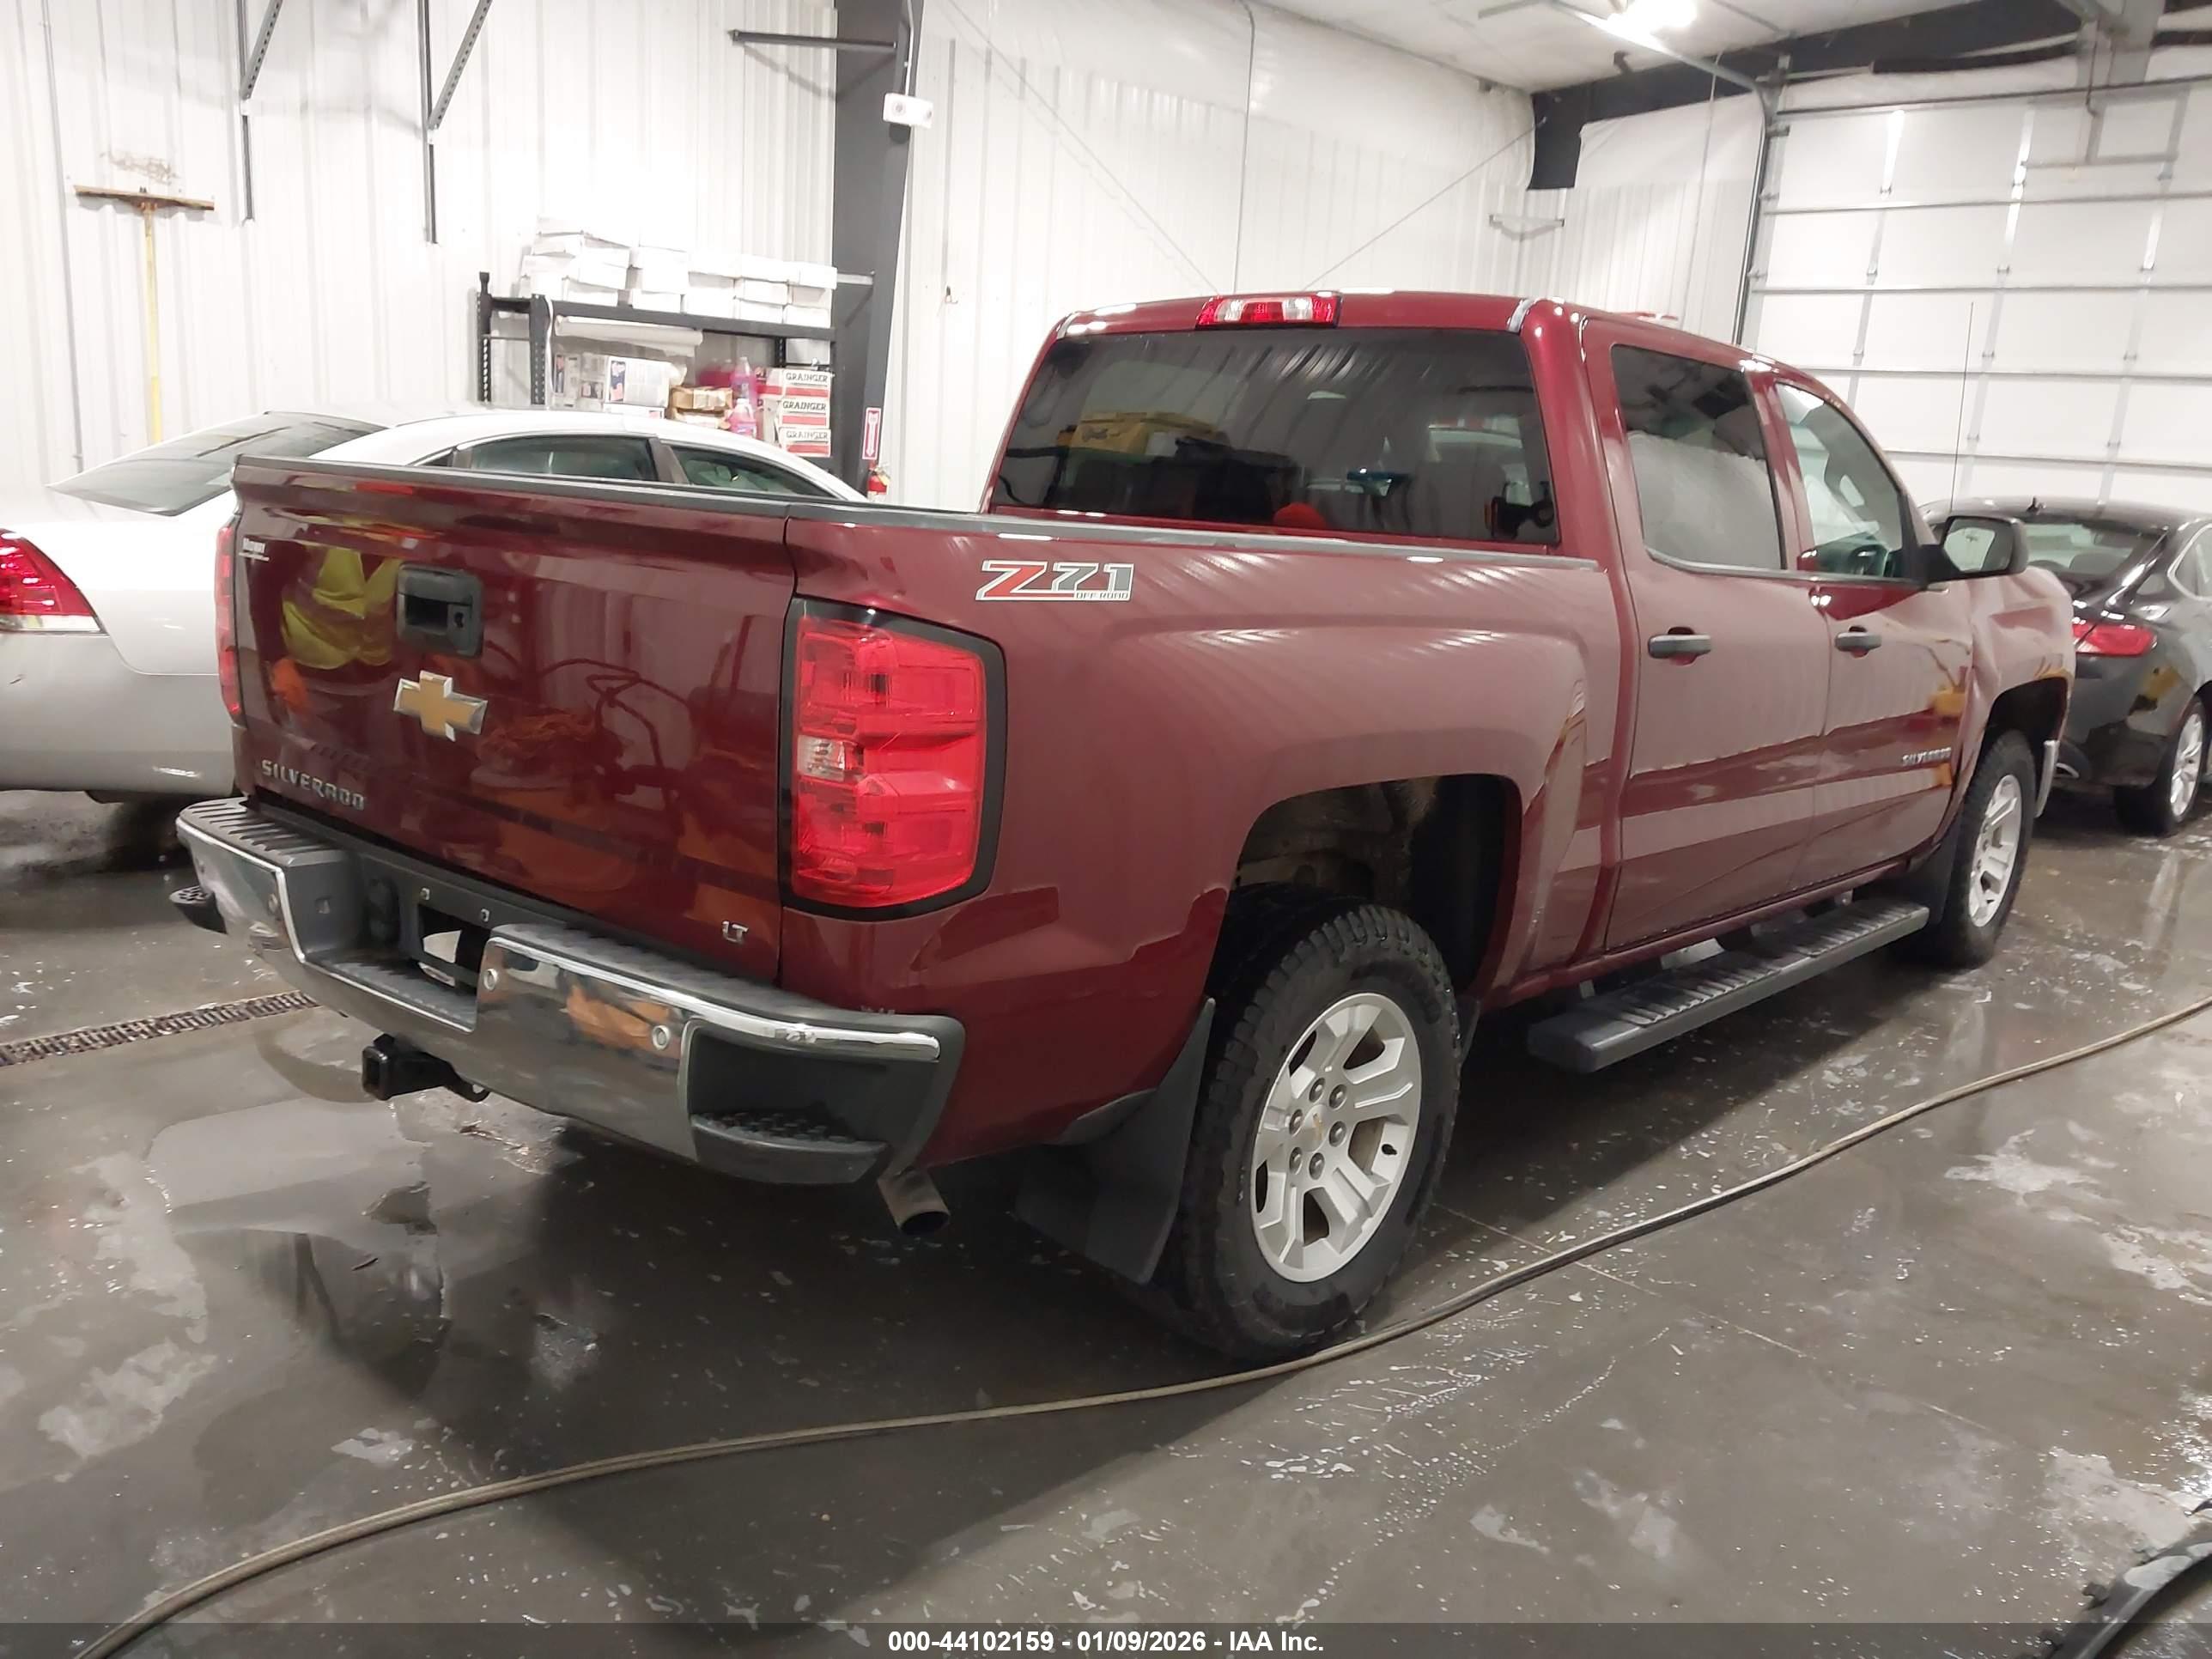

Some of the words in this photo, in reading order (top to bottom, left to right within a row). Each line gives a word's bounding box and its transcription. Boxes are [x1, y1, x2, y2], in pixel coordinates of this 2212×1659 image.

[786, 373, 828, 383] GRAINGER
[782, 401, 826, 410] GRAINGER
[786, 431, 828, 440] GRAINGER
[975, 560, 1134, 601] Z71
[261, 759, 365, 811] SILVERADO
[721, 921, 749, 944] LT
